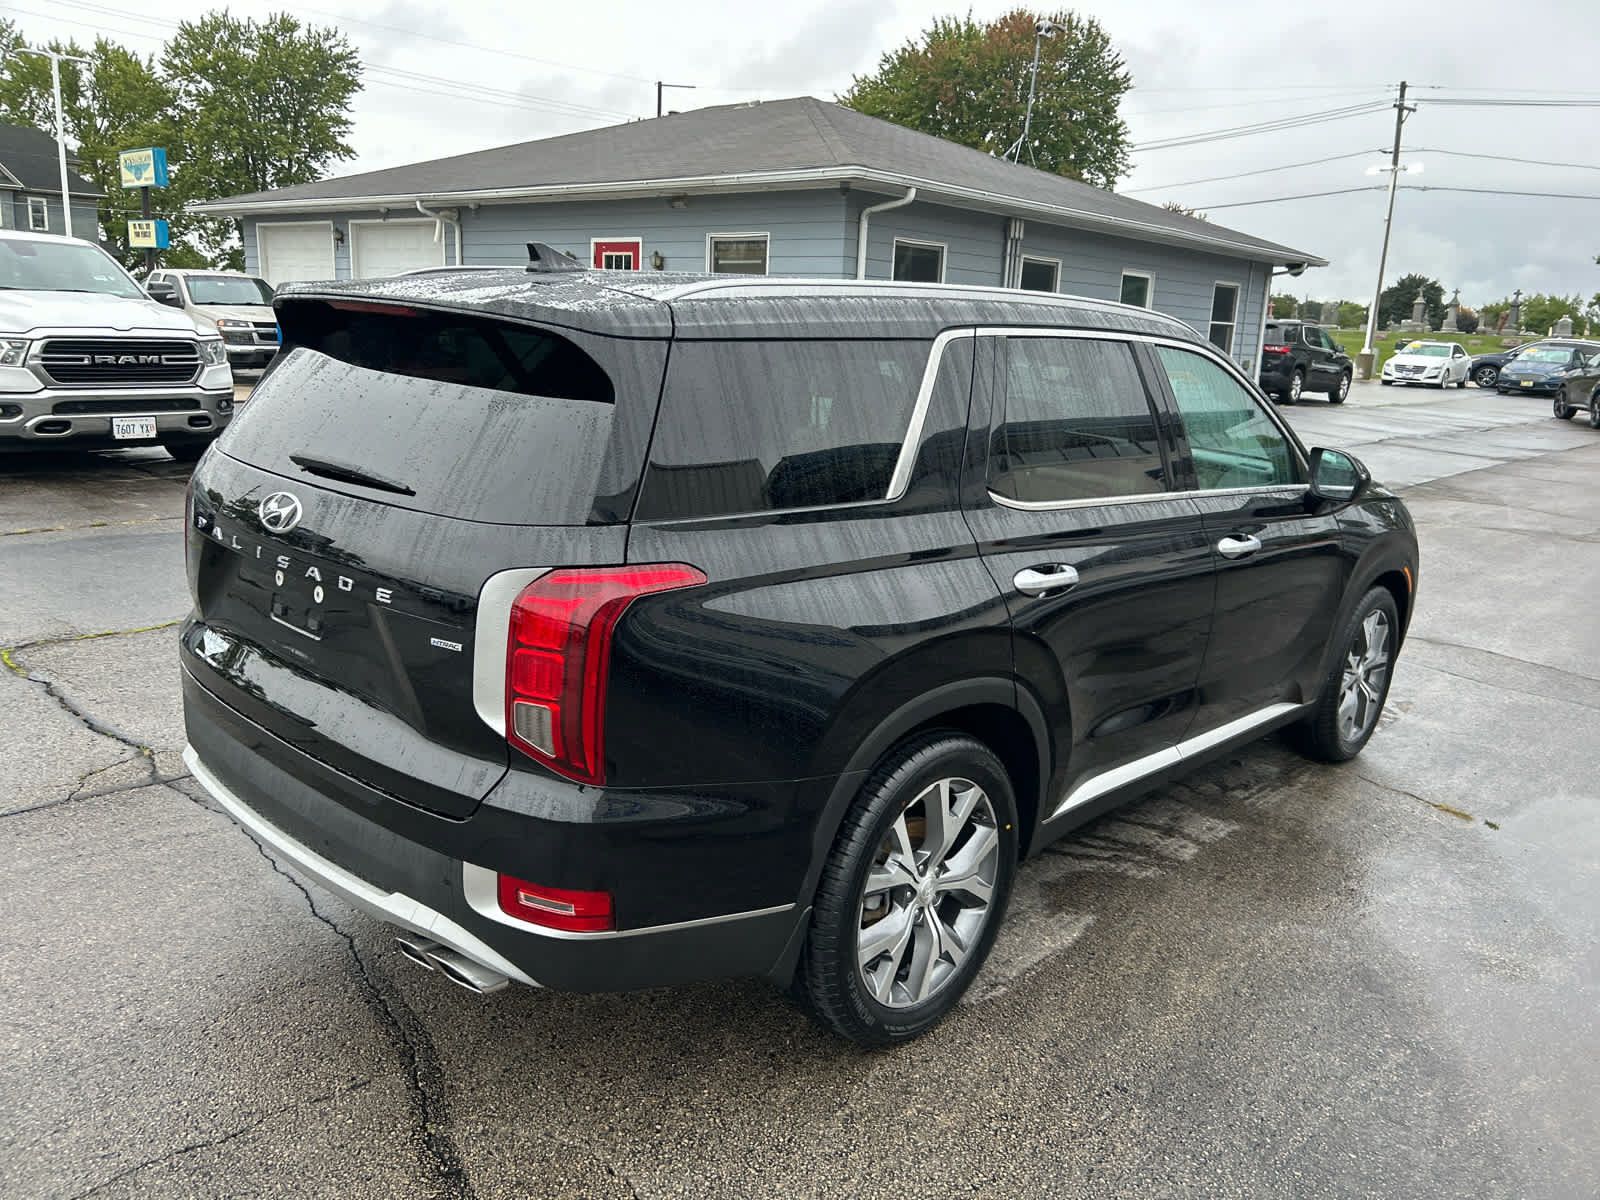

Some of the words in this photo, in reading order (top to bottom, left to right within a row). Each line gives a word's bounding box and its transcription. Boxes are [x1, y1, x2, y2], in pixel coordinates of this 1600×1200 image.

[94, 355, 159, 364] RAM
[115, 424, 136, 434] 7607
[198, 515, 393, 604] PALISADE
